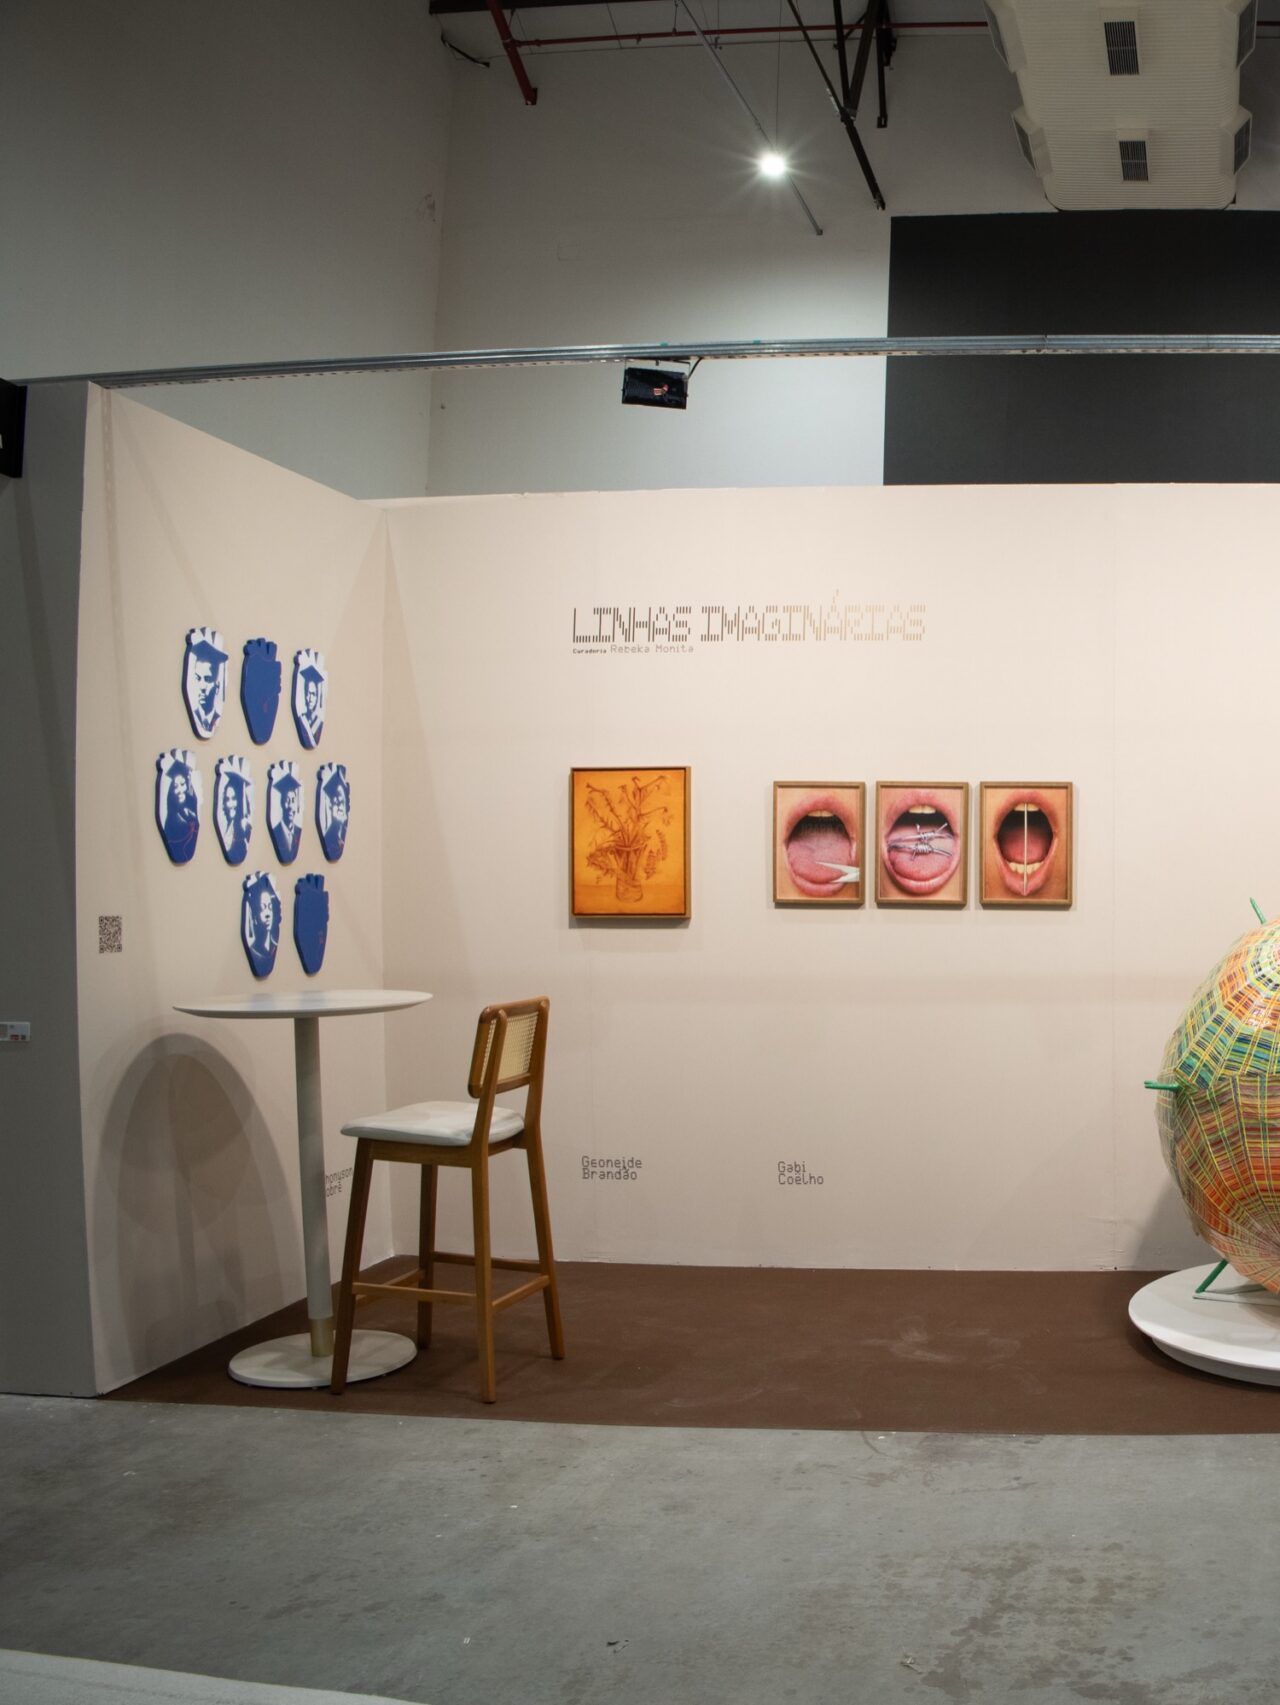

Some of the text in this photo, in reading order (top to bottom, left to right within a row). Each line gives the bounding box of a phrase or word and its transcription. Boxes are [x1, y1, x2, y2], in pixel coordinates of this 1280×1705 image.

[573, 605, 692, 643] LINHAS
[610, 644, 650, 654] Rebeka
[655, 644, 694, 654] Monita
[581, 1155, 643, 1169] Geoneide
[777, 1160, 806, 1173] Gabi
[581, 1167, 638, 1181] Brandão
